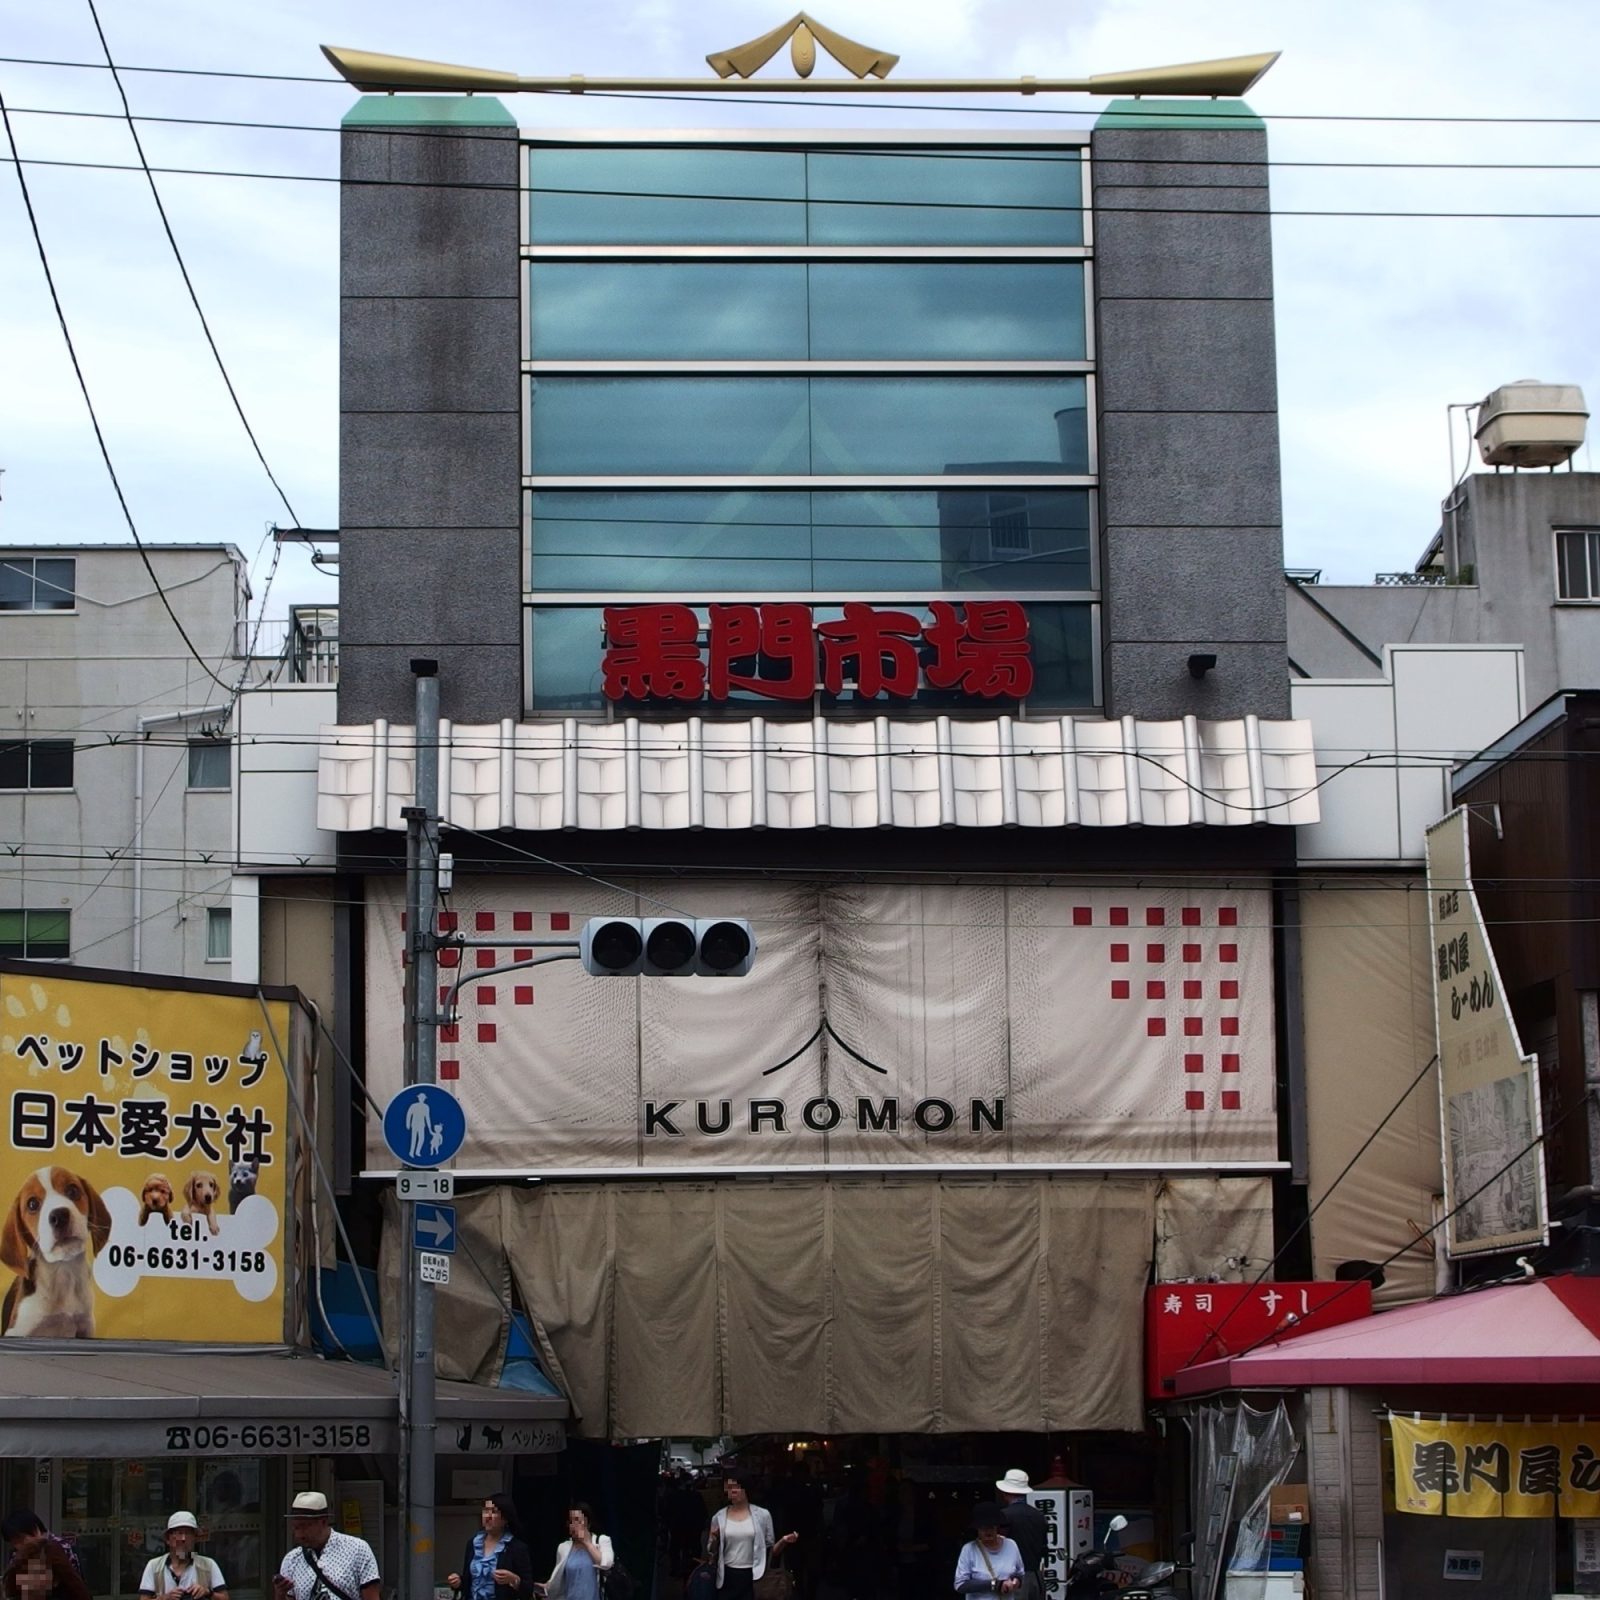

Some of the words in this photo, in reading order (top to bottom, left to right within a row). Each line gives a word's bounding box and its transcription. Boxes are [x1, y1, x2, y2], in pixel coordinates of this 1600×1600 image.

[603, 602, 1033, 699] 黒門市場
[1451, 971, 1494, 1020] らーめん
[17, 1036, 268, 1086] ペットショップ
[12, 1091, 272, 1164] 日本愛犬社
[643, 1096, 1005, 1136] KUROMON
[169, 1221, 208, 1241] tel.
[109, 1245, 265, 1272] 06-6631-3158
[1164, 1293, 1212, 1315] 寿司
[1259, 1289, 1308, 1317] すし
[194, 1425, 370, 1448] 06-6631-3158
